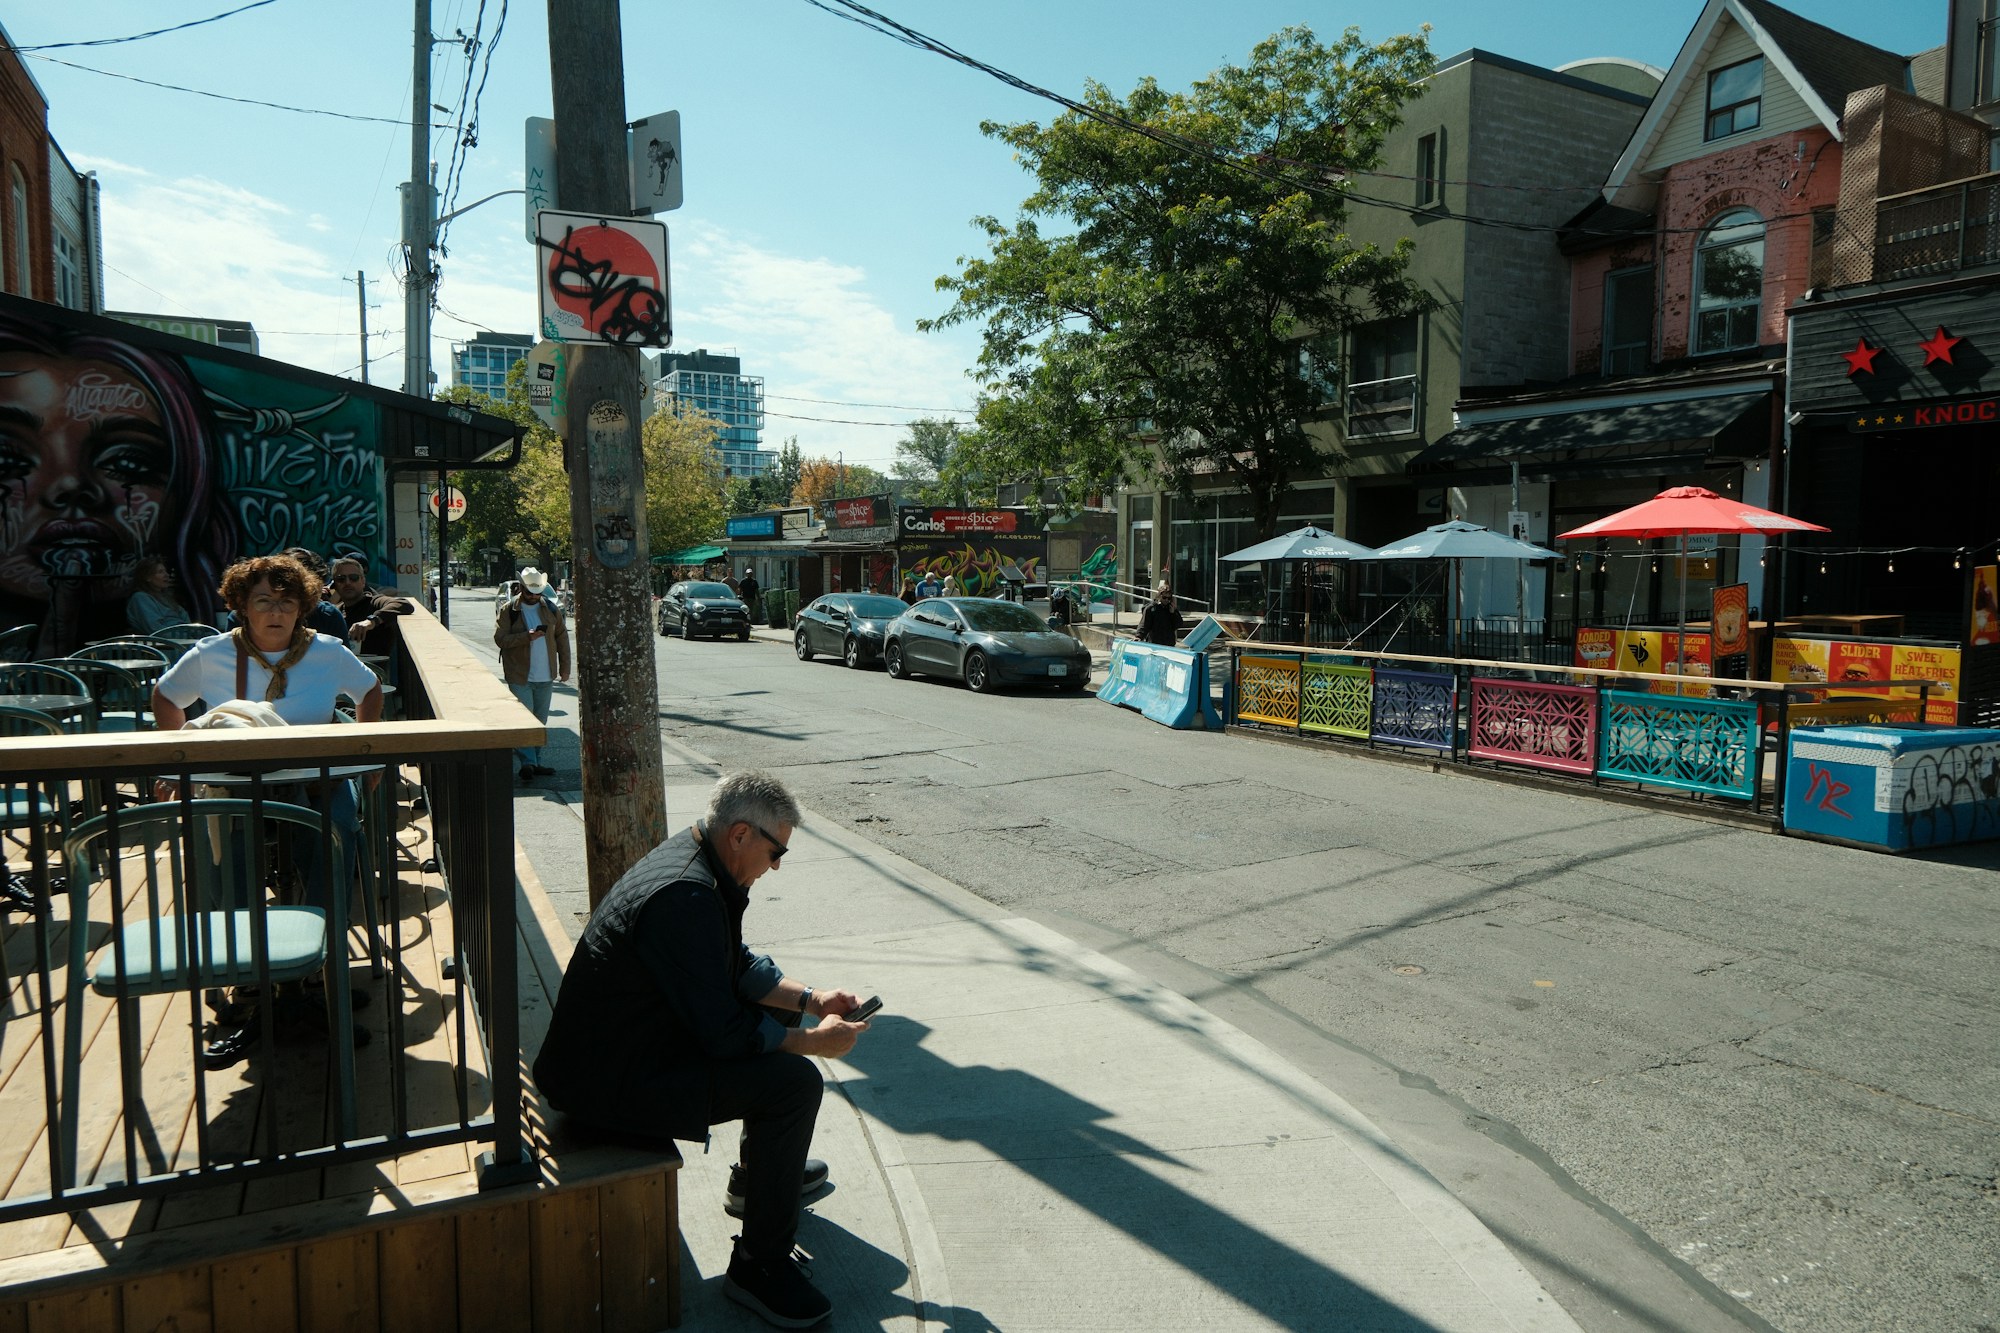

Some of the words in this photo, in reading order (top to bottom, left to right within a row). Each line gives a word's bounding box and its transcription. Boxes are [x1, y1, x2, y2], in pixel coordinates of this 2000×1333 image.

[966, 512, 1003, 526] spice
[1302, 548, 1351, 556] Corona
[1577, 631, 1611, 643] LOADED
[1775, 642, 1810, 651] KNOCKOUT
[1840, 644, 1881, 659] SLIDER
[1775, 651, 1797, 659] RANCH
[1587, 658, 1609, 669] FRIES
[1894, 664, 1922, 677] HEAT
[1926, 666, 1956, 679] FRIES
[1686, 687, 1708, 696] WINGS
